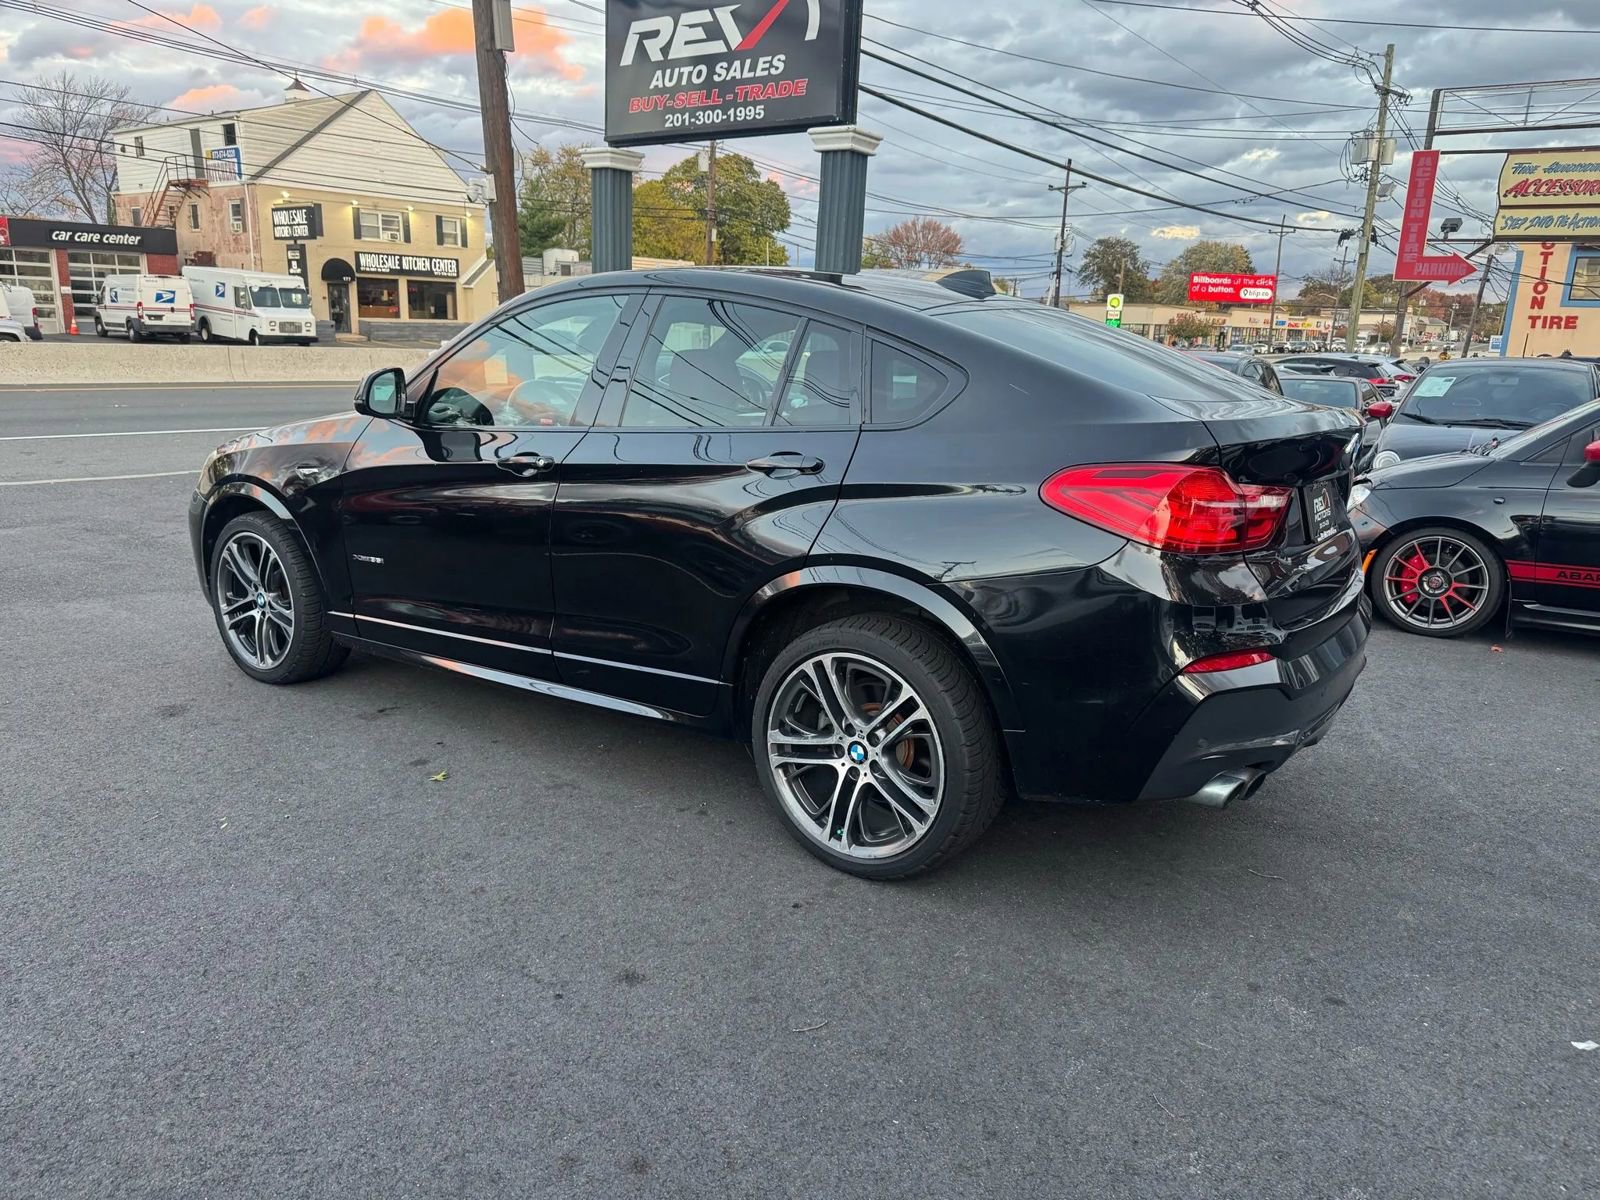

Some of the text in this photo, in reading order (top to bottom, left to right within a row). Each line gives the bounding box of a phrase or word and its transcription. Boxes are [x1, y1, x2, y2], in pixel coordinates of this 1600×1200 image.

[649, 54, 786, 89] AUTO SALES
[664, 105, 764, 128] 201-300-1995
[1409, 157, 1432, 218] ACTION
[273, 209, 307, 225] WHOLESALE
[51, 230, 141, 245] car care center
[274, 225, 309, 237] KITCHEN CENTER
[1403, 222, 1423, 262] TIRE
[359, 253, 457, 273] WHOLESALE KITCHEN CENTER
[1414, 262, 1466, 276] PARKING
[1193, 275, 1232, 284] Billboards
[1256, 277, 1273, 286] click
[1528, 315, 1579, 330] TIRE
